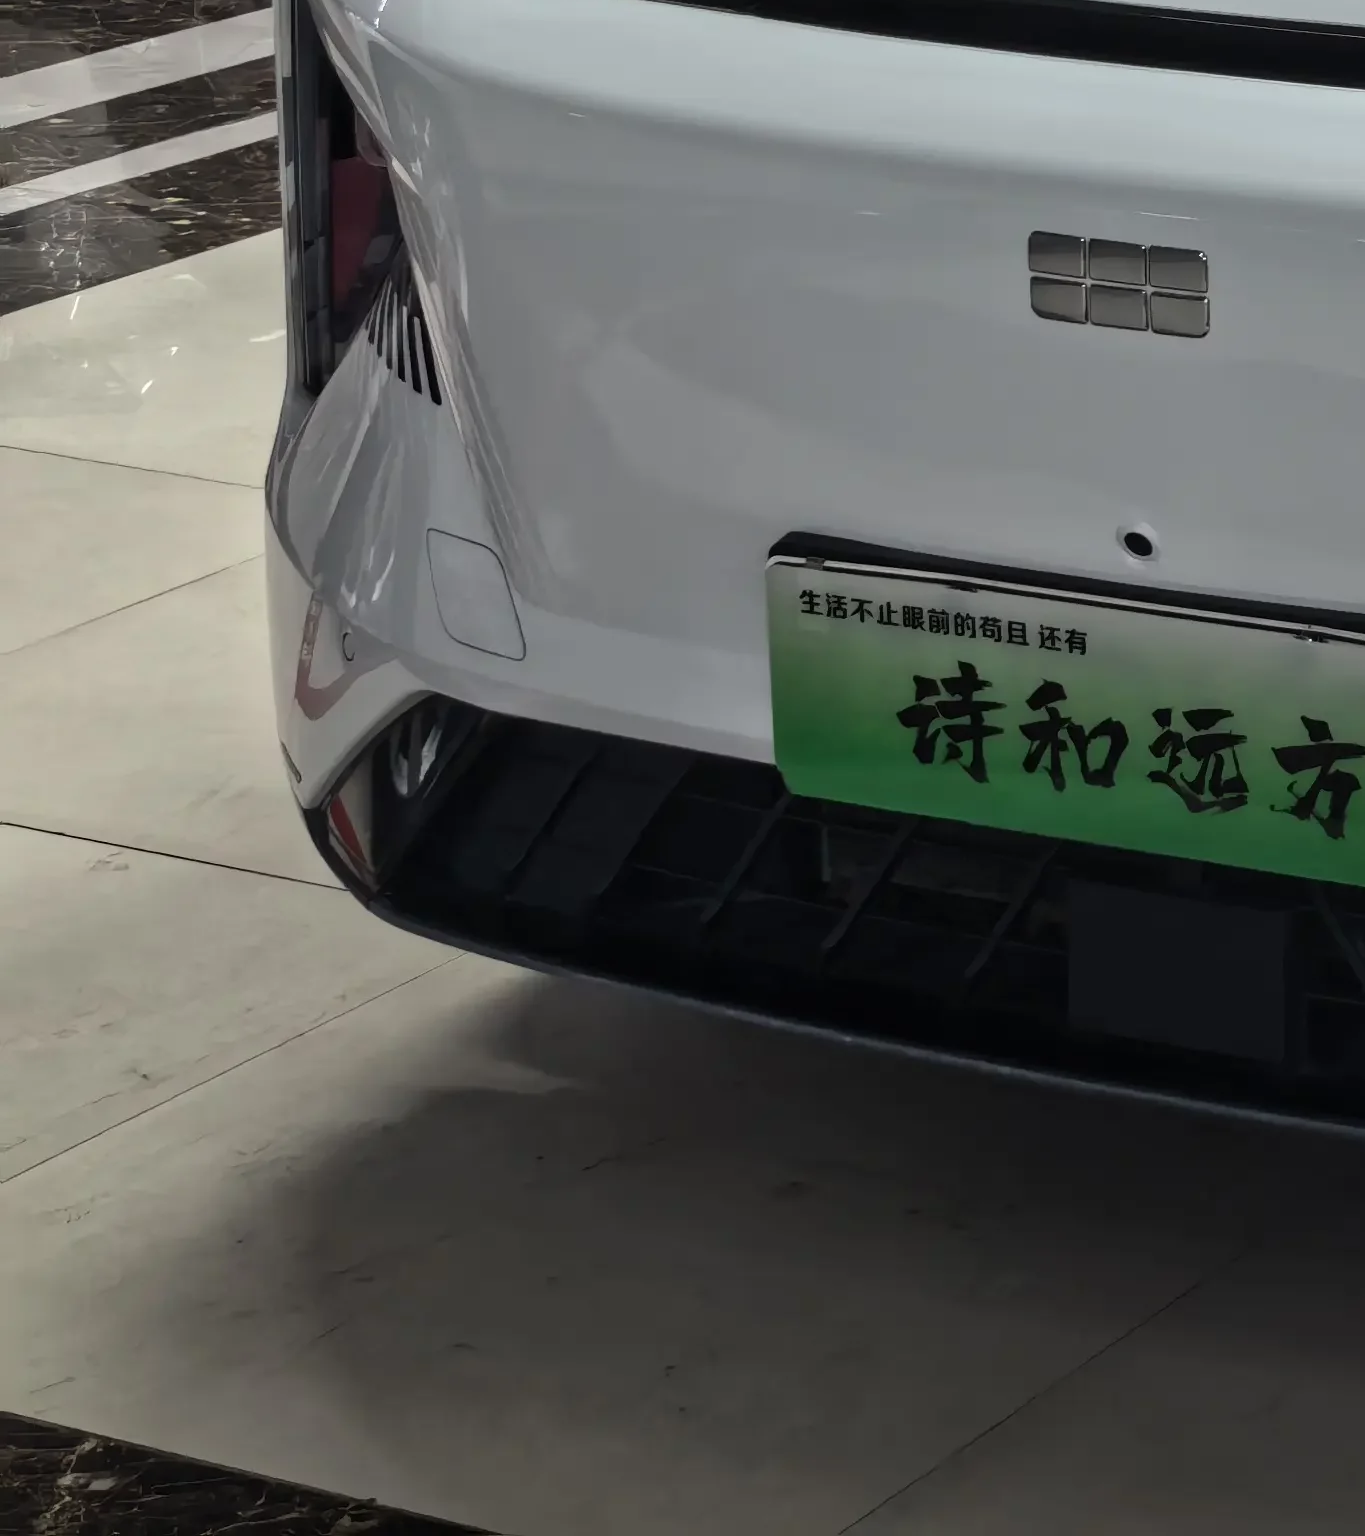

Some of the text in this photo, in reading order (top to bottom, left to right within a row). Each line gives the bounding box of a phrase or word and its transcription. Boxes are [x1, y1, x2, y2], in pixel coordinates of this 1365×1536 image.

[799, 589, 1088, 656] 生活不止眼前的苟且 还有
